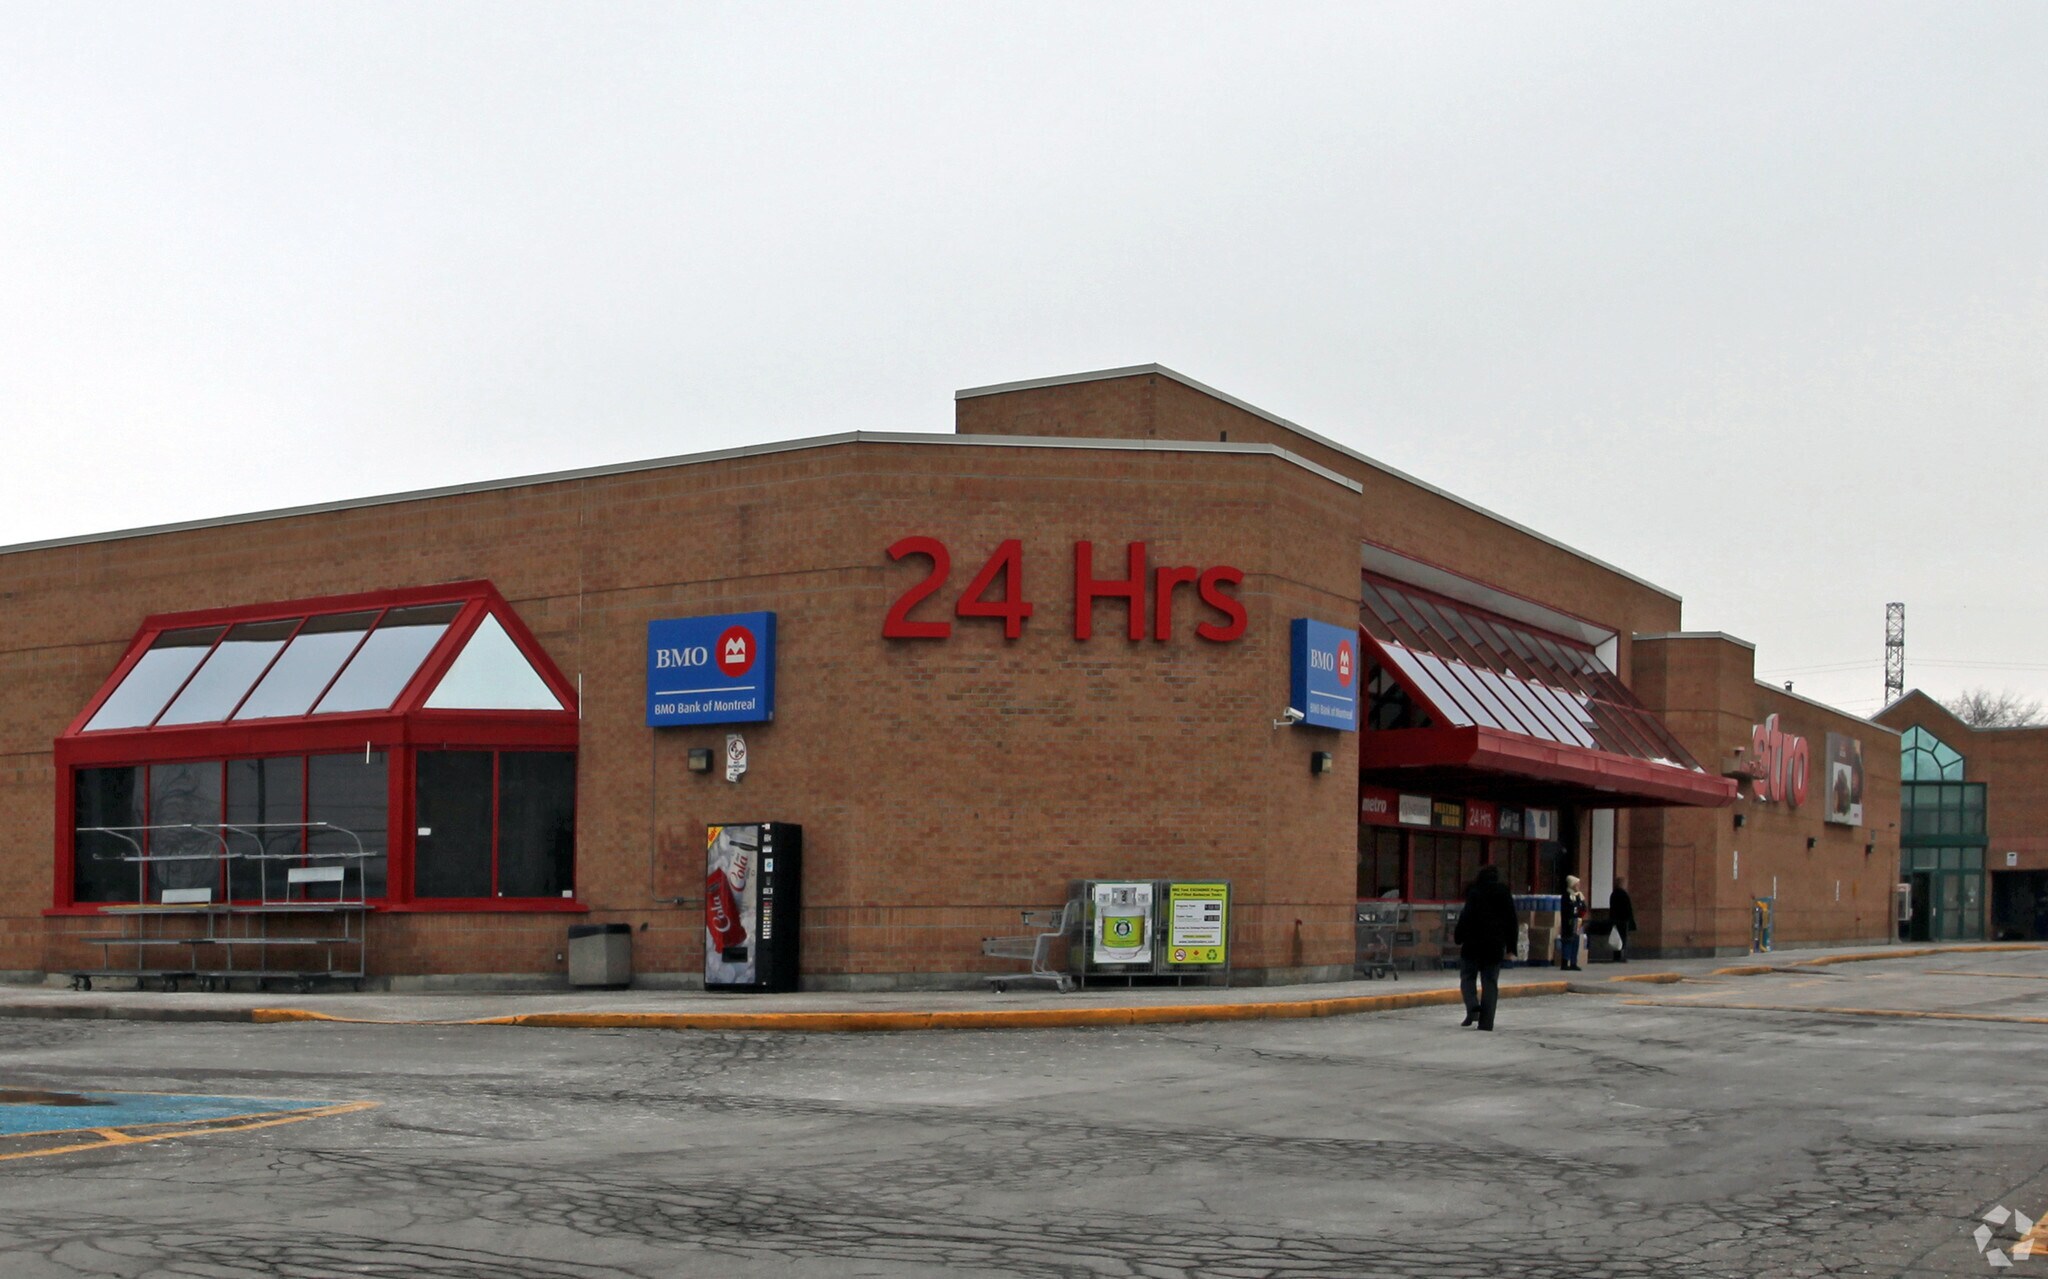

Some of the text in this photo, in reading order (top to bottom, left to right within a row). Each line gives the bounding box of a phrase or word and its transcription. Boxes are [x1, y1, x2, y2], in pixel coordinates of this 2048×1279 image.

[882, 535, 1248, 642] 24 Hrs
[656, 646, 708, 668] BMO
[1310, 649, 1334, 671] BMO
[655, 697, 756, 715] BMO Bank of Montreal
[1752, 713, 1809, 806] etro
[1362, 797, 1387, 813] metro
[1469, 808, 1479, 826] 24
[1480, 808, 1492, 828] Hrs
[730, 855, 748, 892] Cola
[711, 895, 731, 932] Cola
